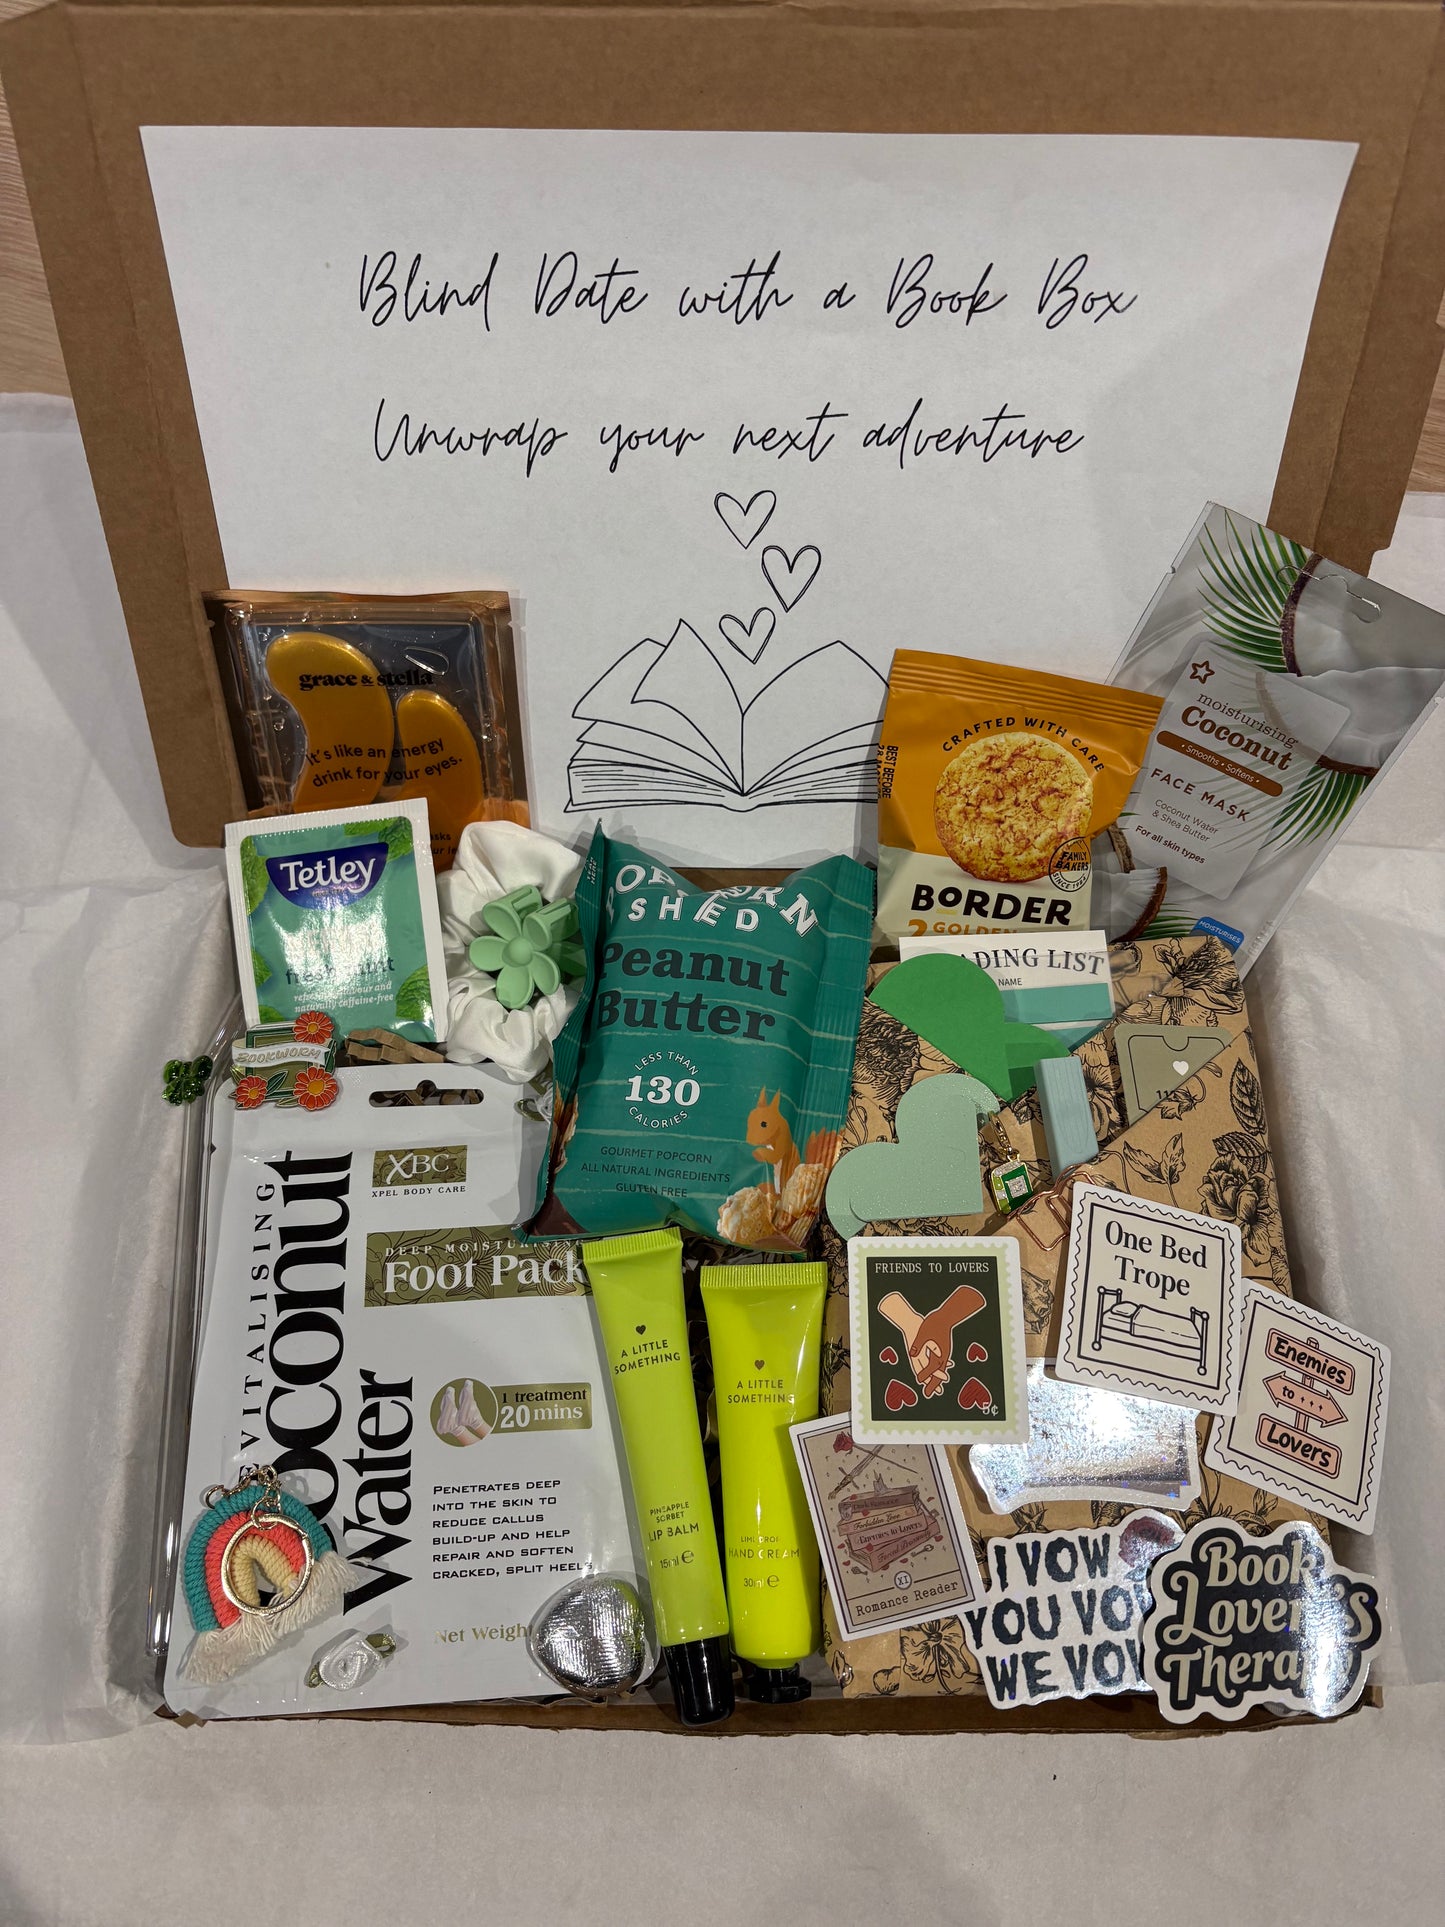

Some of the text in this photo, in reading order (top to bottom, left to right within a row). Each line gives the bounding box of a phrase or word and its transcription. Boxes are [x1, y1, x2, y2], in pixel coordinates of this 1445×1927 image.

[360, 250, 1138, 332] Blind Date with a Book Box
[374, 398, 1085, 478] Unwrap your next adventure
[299, 669, 434, 692] grace & stella
[1196, 692, 1299, 749] moisturising
[305, 737, 445, 767] It's like an energy
[943, 717, 1105, 773] CRAFTED WITH CARE
[1181, 705, 1293, 772] Coconut
[312, 756, 463, 788] drink for your eyes.
[881, 745, 899, 799] BEST BEFORE
[1185, 744, 1255, 784] Smooths Softens
[1150, 768, 1251, 822] FACE MASK
[1155, 799, 1219, 835] Coconut Water
[1160, 812, 1181, 830] Shea
[1181, 823, 1211, 844] Butter
[1135, 825, 1206, 865] For all skin types
[1055, 851, 1089, 871] FAMILY BAKERS
[279, 855, 376, 895] Tetley
[1053, 872, 1071, 889] SINCE
[605, 864, 818, 938] POPORN
[627, 893, 759, 932] SHED
[911, 884, 1072, 926] BORDER
[907, 919, 1018, 936] 2 GOLD
[1199, 920, 1241, 944] MOISTURISES
[599, 942, 790, 997] Peanut
[961, 948, 1104, 976] DING LIST
[374, 980, 392, 991] and
[998, 978, 1022, 987] NAME
[598, 989, 776, 1042] Butter
[234, 1046, 322, 1063] BOOKWORM
[634, 1051, 699, 1076] LESS THAN
[624, 1075, 701, 1106] 130
[628, 1106, 689, 1129] CALORIES
[600, 1145, 712, 1164] GOURMET POPCORN
[386, 1152, 450, 1185] XBC
[581, 1163, 731, 1183] ALL NATURAL INGREDIENTS
[372, 1186, 466, 1198] XPEL BODY CARE
[615, 1183, 688, 1198] GLUTEN FREE
[385, 1245, 433, 1257] DEEP
[1104, 1219, 1208, 1271] One Bed
[384, 1250, 588, 1294] Foot Pack
[875, 1262, 989, 1273] FRIENDS TO LOVERS
[1114, 1255, 1190, 1299] Trope
[239, 1183, 276, 1482] EVITALISING
[620, 1339, 669, 1358] A LITTLE
[1273, 1336, 1346, 1385] Enemies
[260, 1150, 353, 1600] oconut
[614, 1352, 681, 1375] SOMETHING
[515, 1388, 588, 1403] treatment
[736, 1379, 784, 1389] A LITTLE
[1282, 1385, 1295, 1400] to
[727, 1393, 795, 1404] SOMETHING
[982, 1401, 999, 1416] 5¢
[500, 1403, 584, 1429] 20 mins
[1267, 1423, 1331, 1467] Lovers
[342, 1368, 413, 1616] Water
[433, 1479, 561, 1495] PENETRATES DEEP
[433, 1496, 557, 1512] INTO THE SKIN TO
[650, 1502, 689, 1515] PINEAPPLE
[656, 1511, 685, 1523] SORBET
[432, 1514, 544, 1529] REDUCE CALLUS
[648, 1522, 699, 1542] LIP BALM
[432, 1529, 571, 1546] BUILD-UP AND HELP
[432, 1546, 574, 1562] REPAIR AND SOFTEN
[729, 1548, 800, 1559] HAND CREAM
[994, 1533, 1110, 1592] I VOW
[1199, 1537, 1318, 1593] Book
[433, 1567, 500, 1580] CRACKED,
[506, 1565, 544, 1575] SPLIT
[897, 1575, 909, 1586] XI
[855, 1581, 959, 1616] Romance Reader
[964, 1594, 1061, 1650] YOU
[434, 1628, 465, 1644] Net
[986, 1651, 1060, 1701] WE
[1163, 1644, 1354, 1703] Thera
